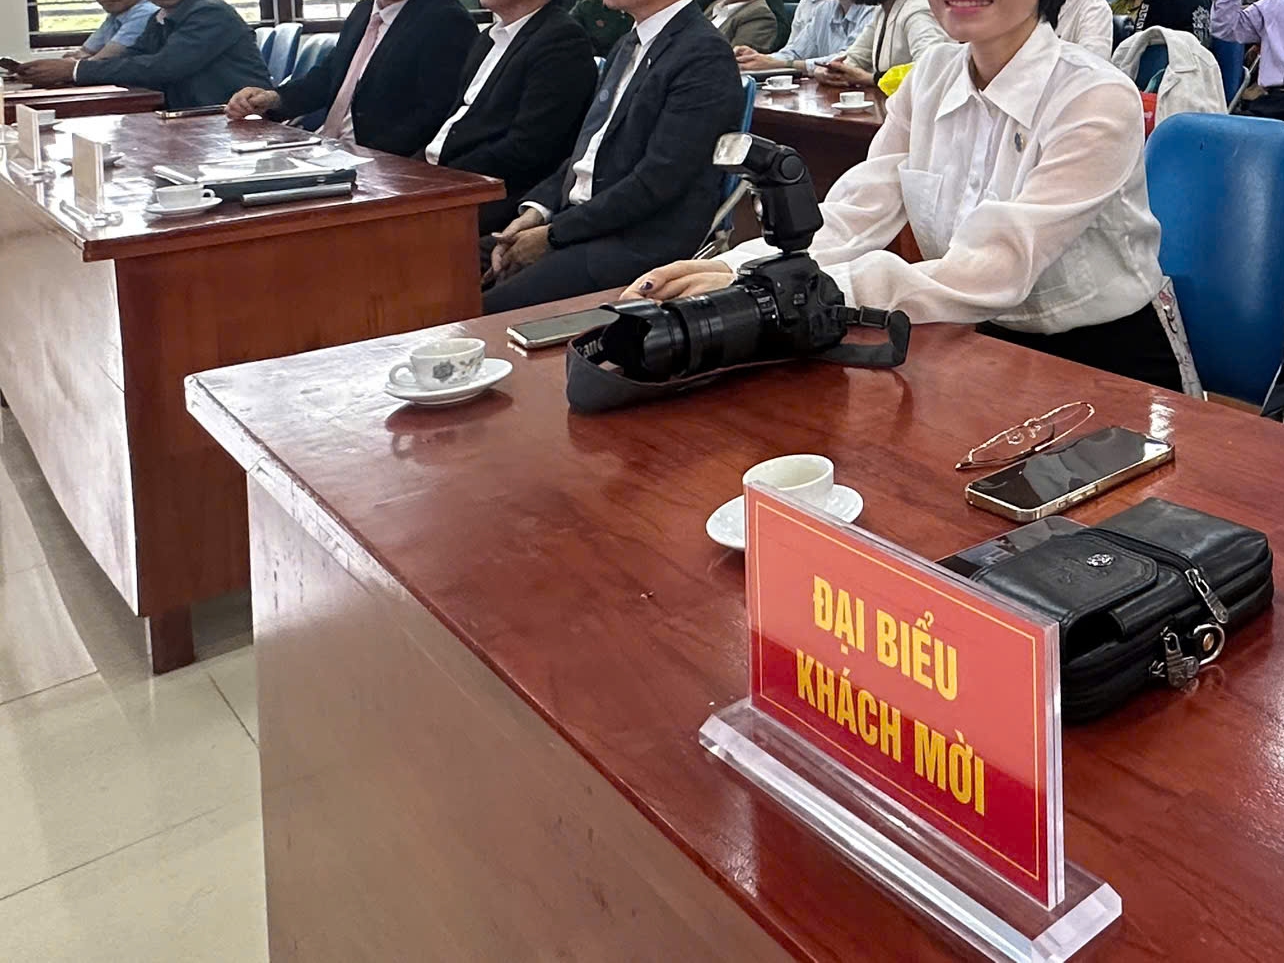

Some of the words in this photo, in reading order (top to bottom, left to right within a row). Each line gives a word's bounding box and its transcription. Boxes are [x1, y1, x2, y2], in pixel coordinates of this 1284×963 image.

[812, 574, 865, 655] ĐẠI
[876, 610, 959, 701] BIỂU
[796, 648, 902, 764] KHÁCH
[914, 719, 985, 816] MỜI
